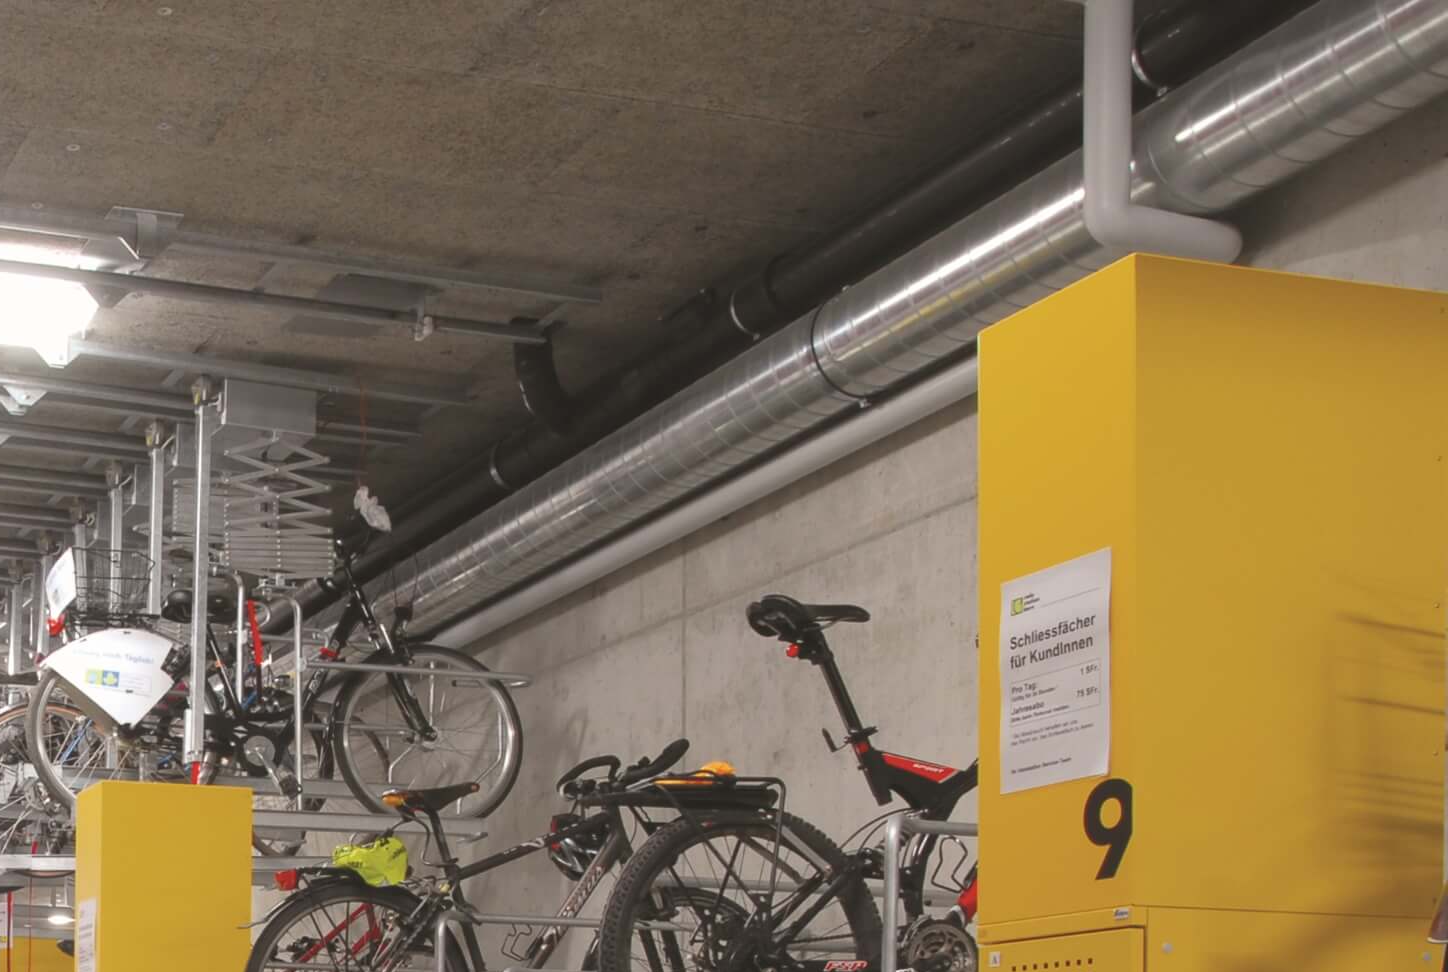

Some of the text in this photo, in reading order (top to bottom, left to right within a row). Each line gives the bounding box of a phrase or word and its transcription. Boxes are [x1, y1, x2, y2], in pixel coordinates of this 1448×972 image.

[1009, 614, 1096, 650] Schliessfächer
[1009, 636, 1094, 669] für KundInnen
[1083, 778, 1134, 880] 9
